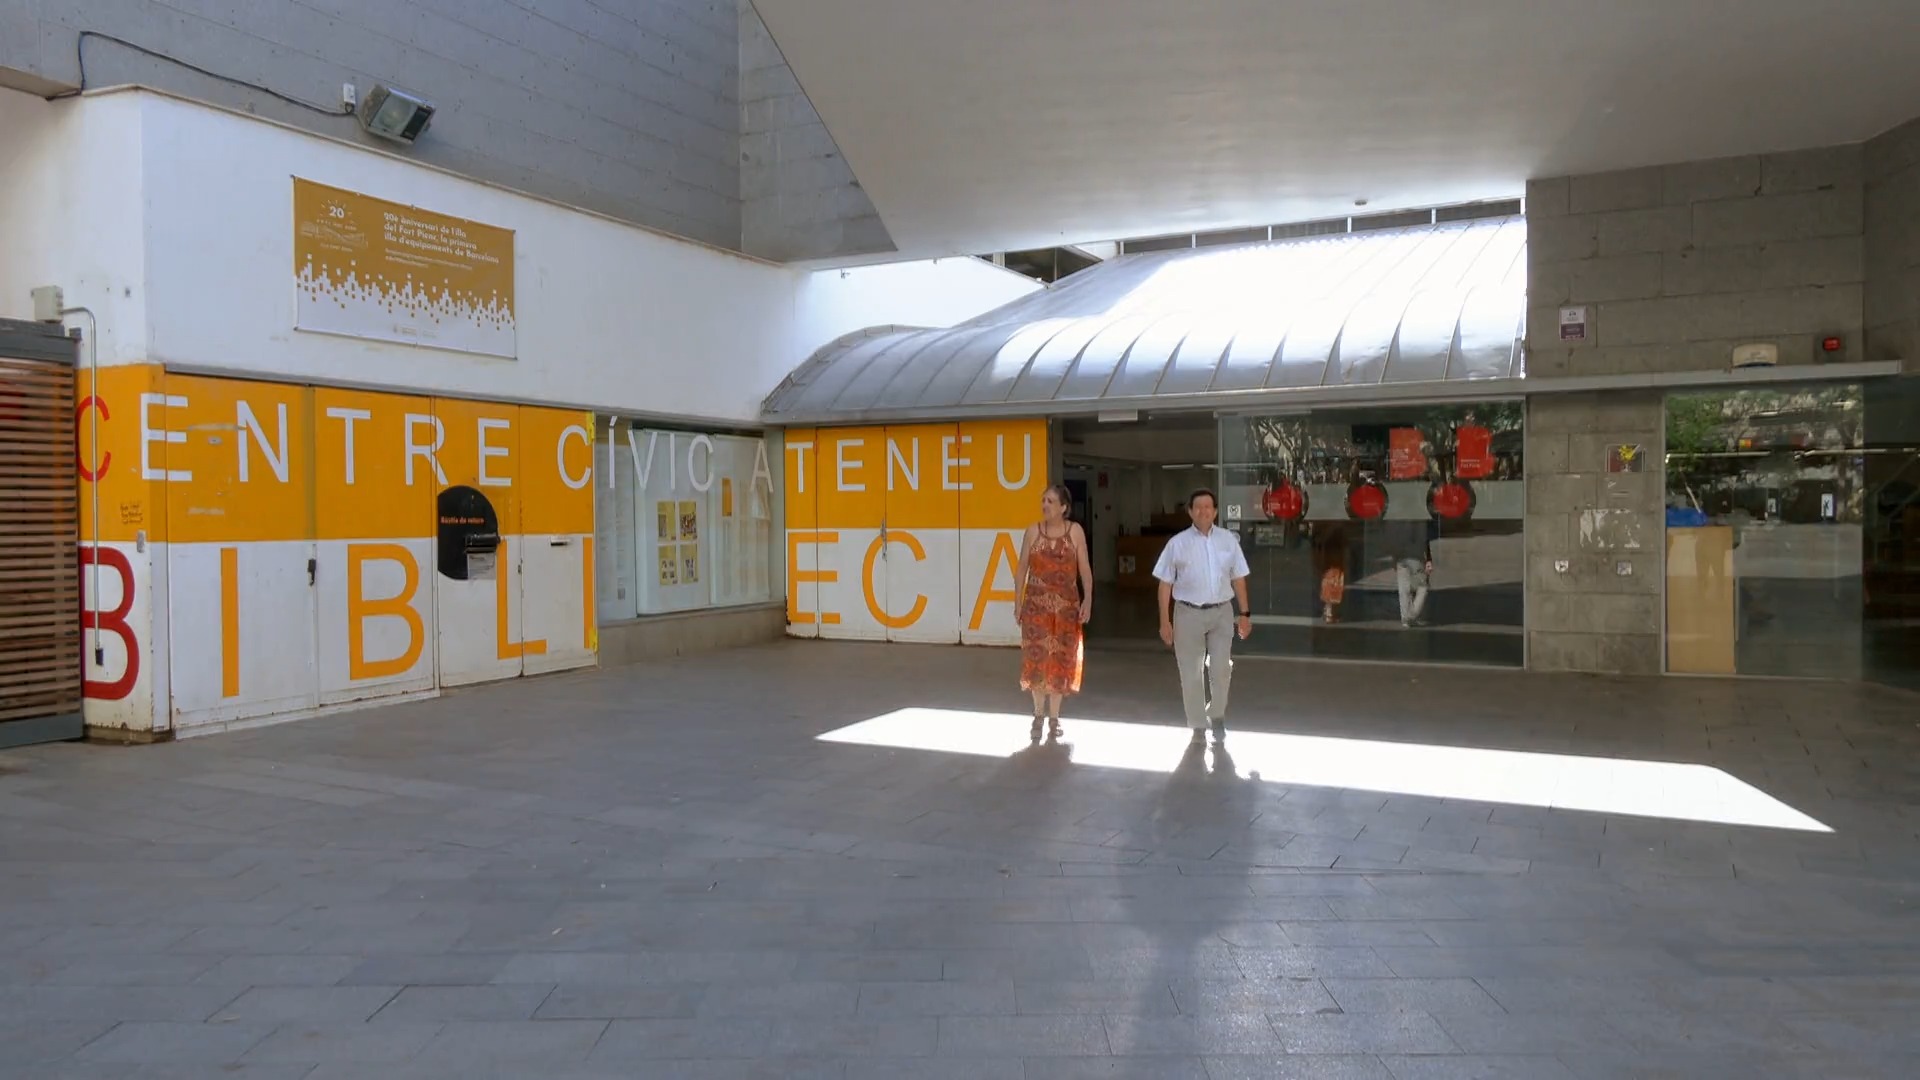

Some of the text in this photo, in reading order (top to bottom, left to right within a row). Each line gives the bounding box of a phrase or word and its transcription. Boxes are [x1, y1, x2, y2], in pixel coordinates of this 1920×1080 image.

[329, 206, 345, 219] 20
[383, 222, 397, 233] del
[399, 224, 415, 237] Fort
[440, 233, 448, 243] la
[449, 238, 477, 250] primera
[440, 224, 450, 234] de
[384, 231, 397, 242] illa
[454, 246, 464, 257] de
[466, 249, 500, 265] Barcelona
[75, 392, 1031, 493] CENTRE CÍVIC ATENEU
